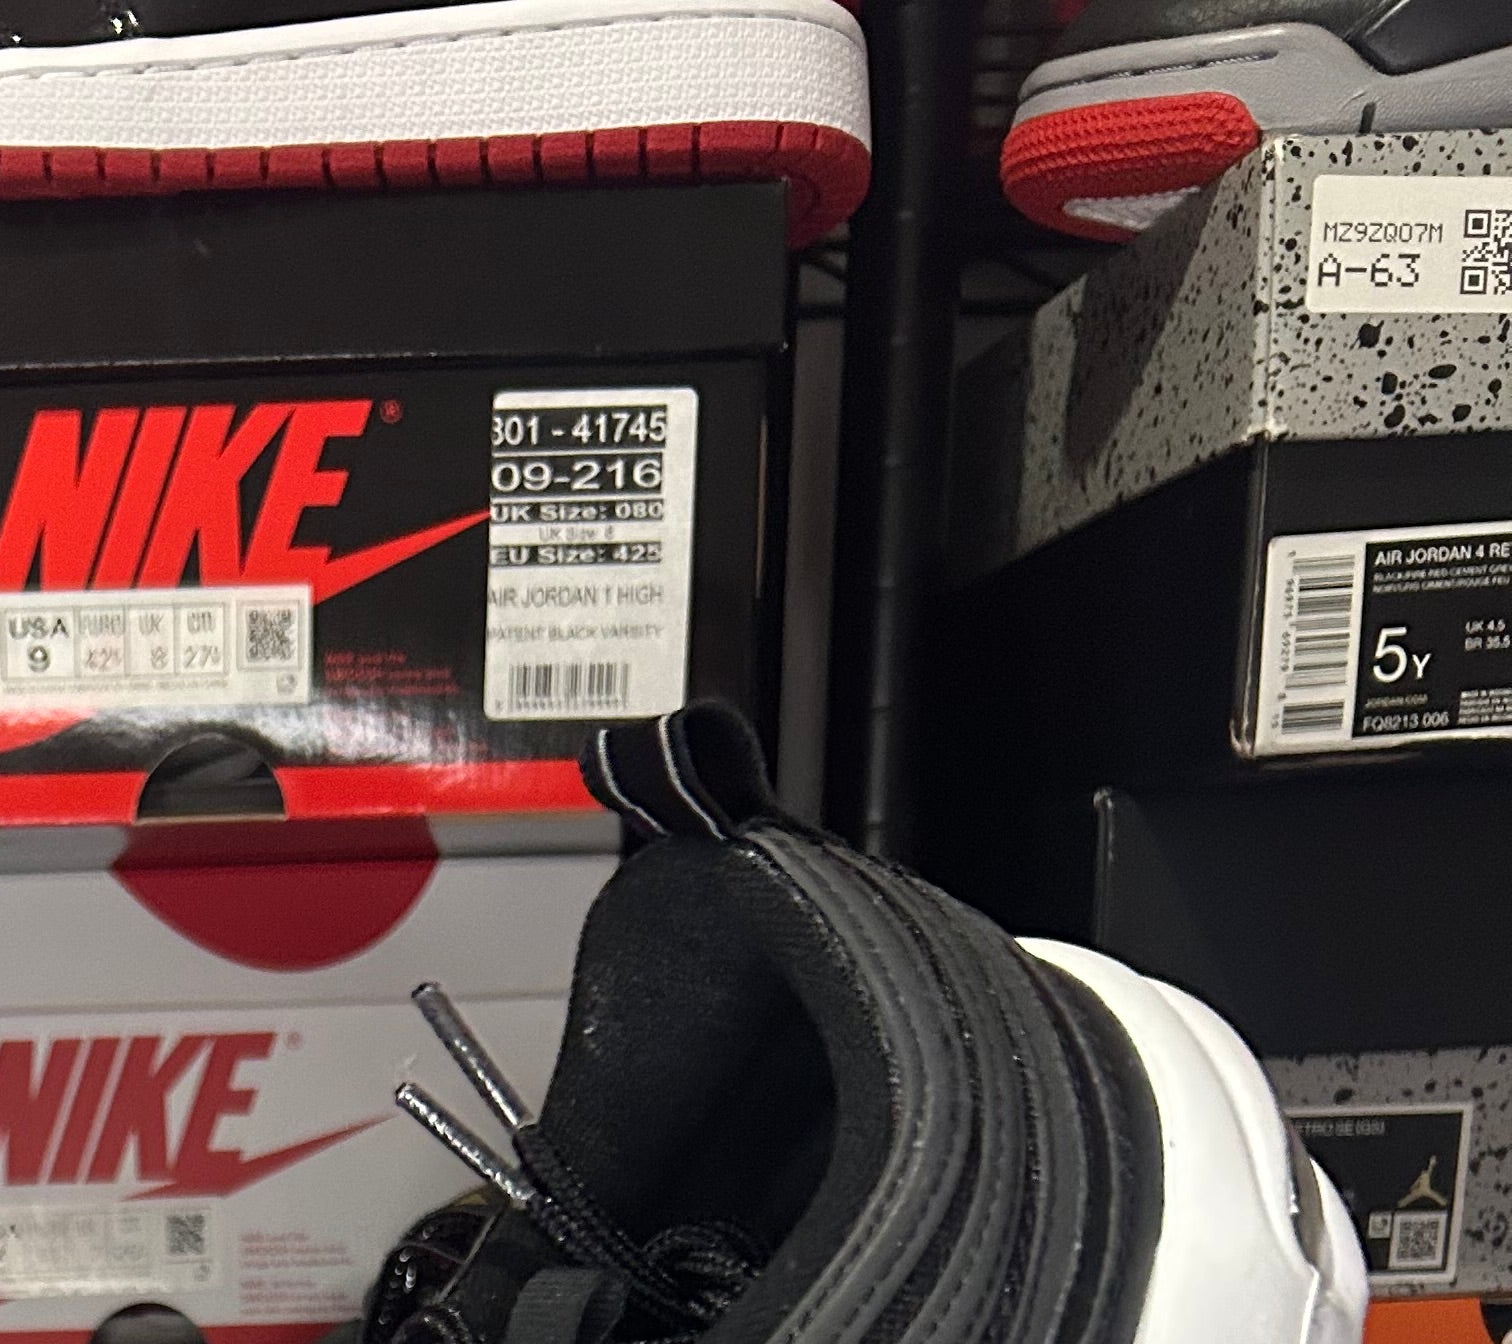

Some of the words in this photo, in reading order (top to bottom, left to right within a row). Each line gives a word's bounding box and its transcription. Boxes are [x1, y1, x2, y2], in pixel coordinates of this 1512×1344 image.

[1318, 253, 1421, 288] A-63
[571, 409, 666, 444] 41745
[491, 504, 532, 522] UK
[490, 546, 531, 566] EU
[1374, 549, 1403, 566] AIR
[1406, 544, 1472, 563] JORDAN
[521, 583, 596, 608] JORDAN
[617, 583, 664, 605] HIGH
[8, 616, 71, 640] USA
